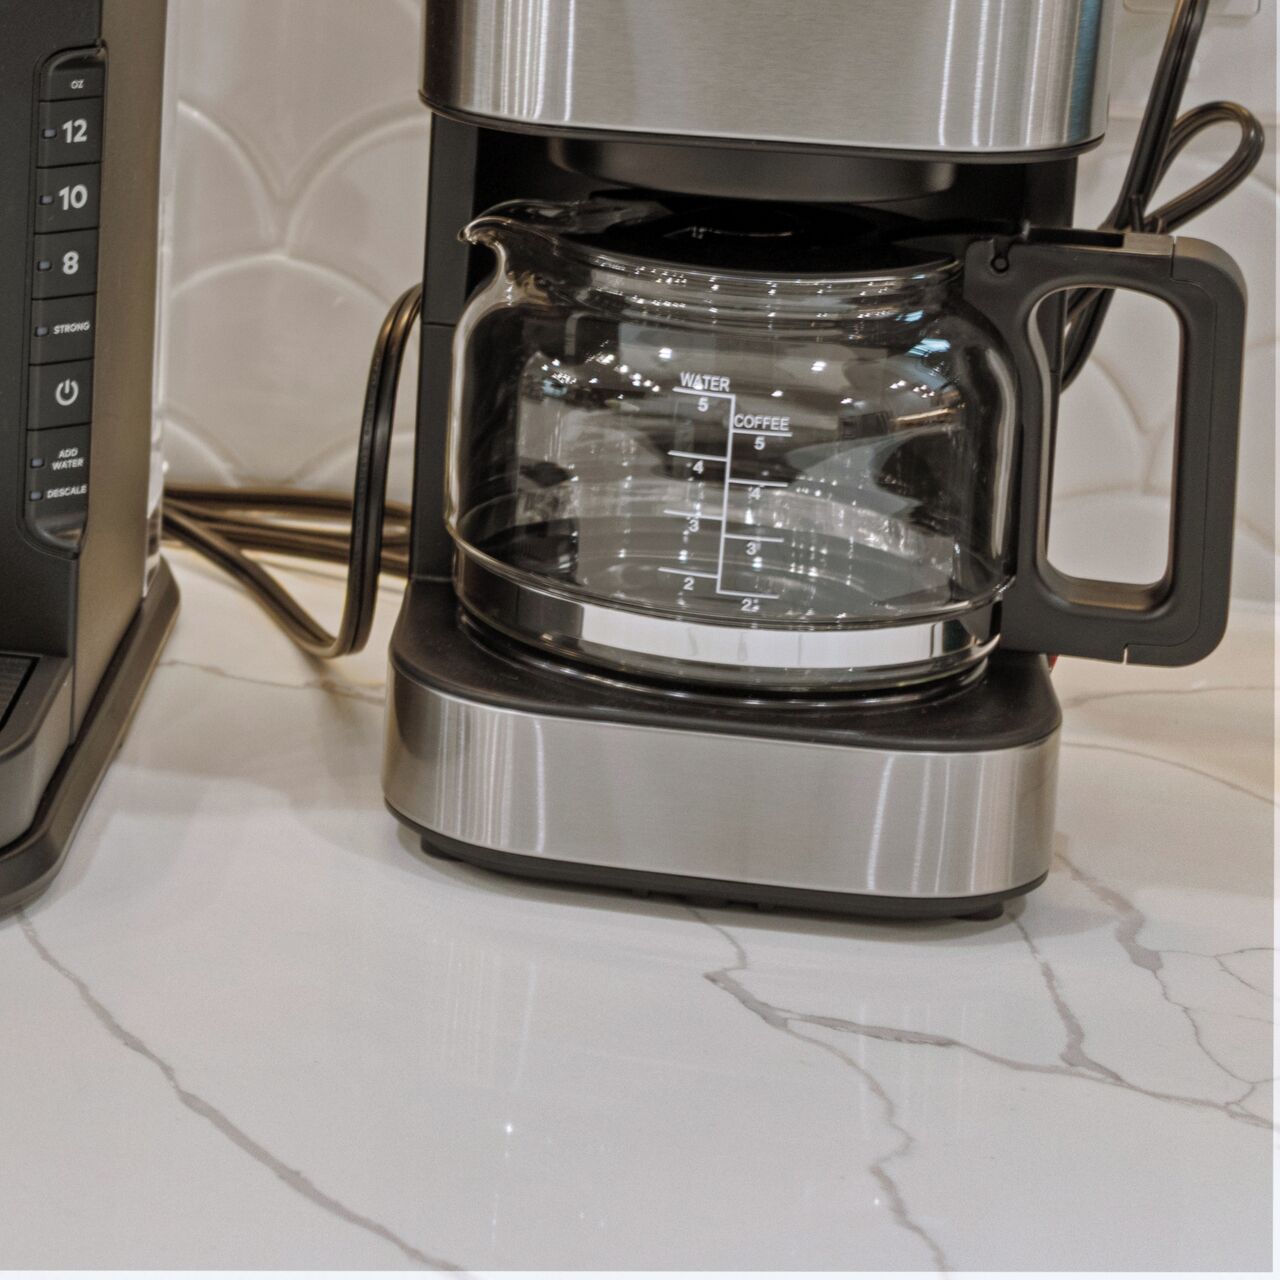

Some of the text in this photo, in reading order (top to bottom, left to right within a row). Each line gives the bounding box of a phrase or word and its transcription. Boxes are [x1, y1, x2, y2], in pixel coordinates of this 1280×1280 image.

[61, 118, 88, 144] 12
[58, 184, 88, 210] 10
[62, 250, 79, 275] 8
[53, 321, 90, 335] STRONG
[680, 371, 730, 392] WATER
[697, 397, 709, 412] 5
[734, 415, 790, 432] COFFEE
[753, 436, 766, 451] 5
[58, 447, 79, 459] ADD
[52, 458, 84, 471] WATER
[692, 460, 704, 474] 4
[47, 484, 87, 499] DESCALE
[750, 487, 761, 500] 4
[689, 519, 700, 532] 3
[746, 542, 756, 556] 3
[683, 577, 694, 591] 2
[741, 599, 752, 612] 2
